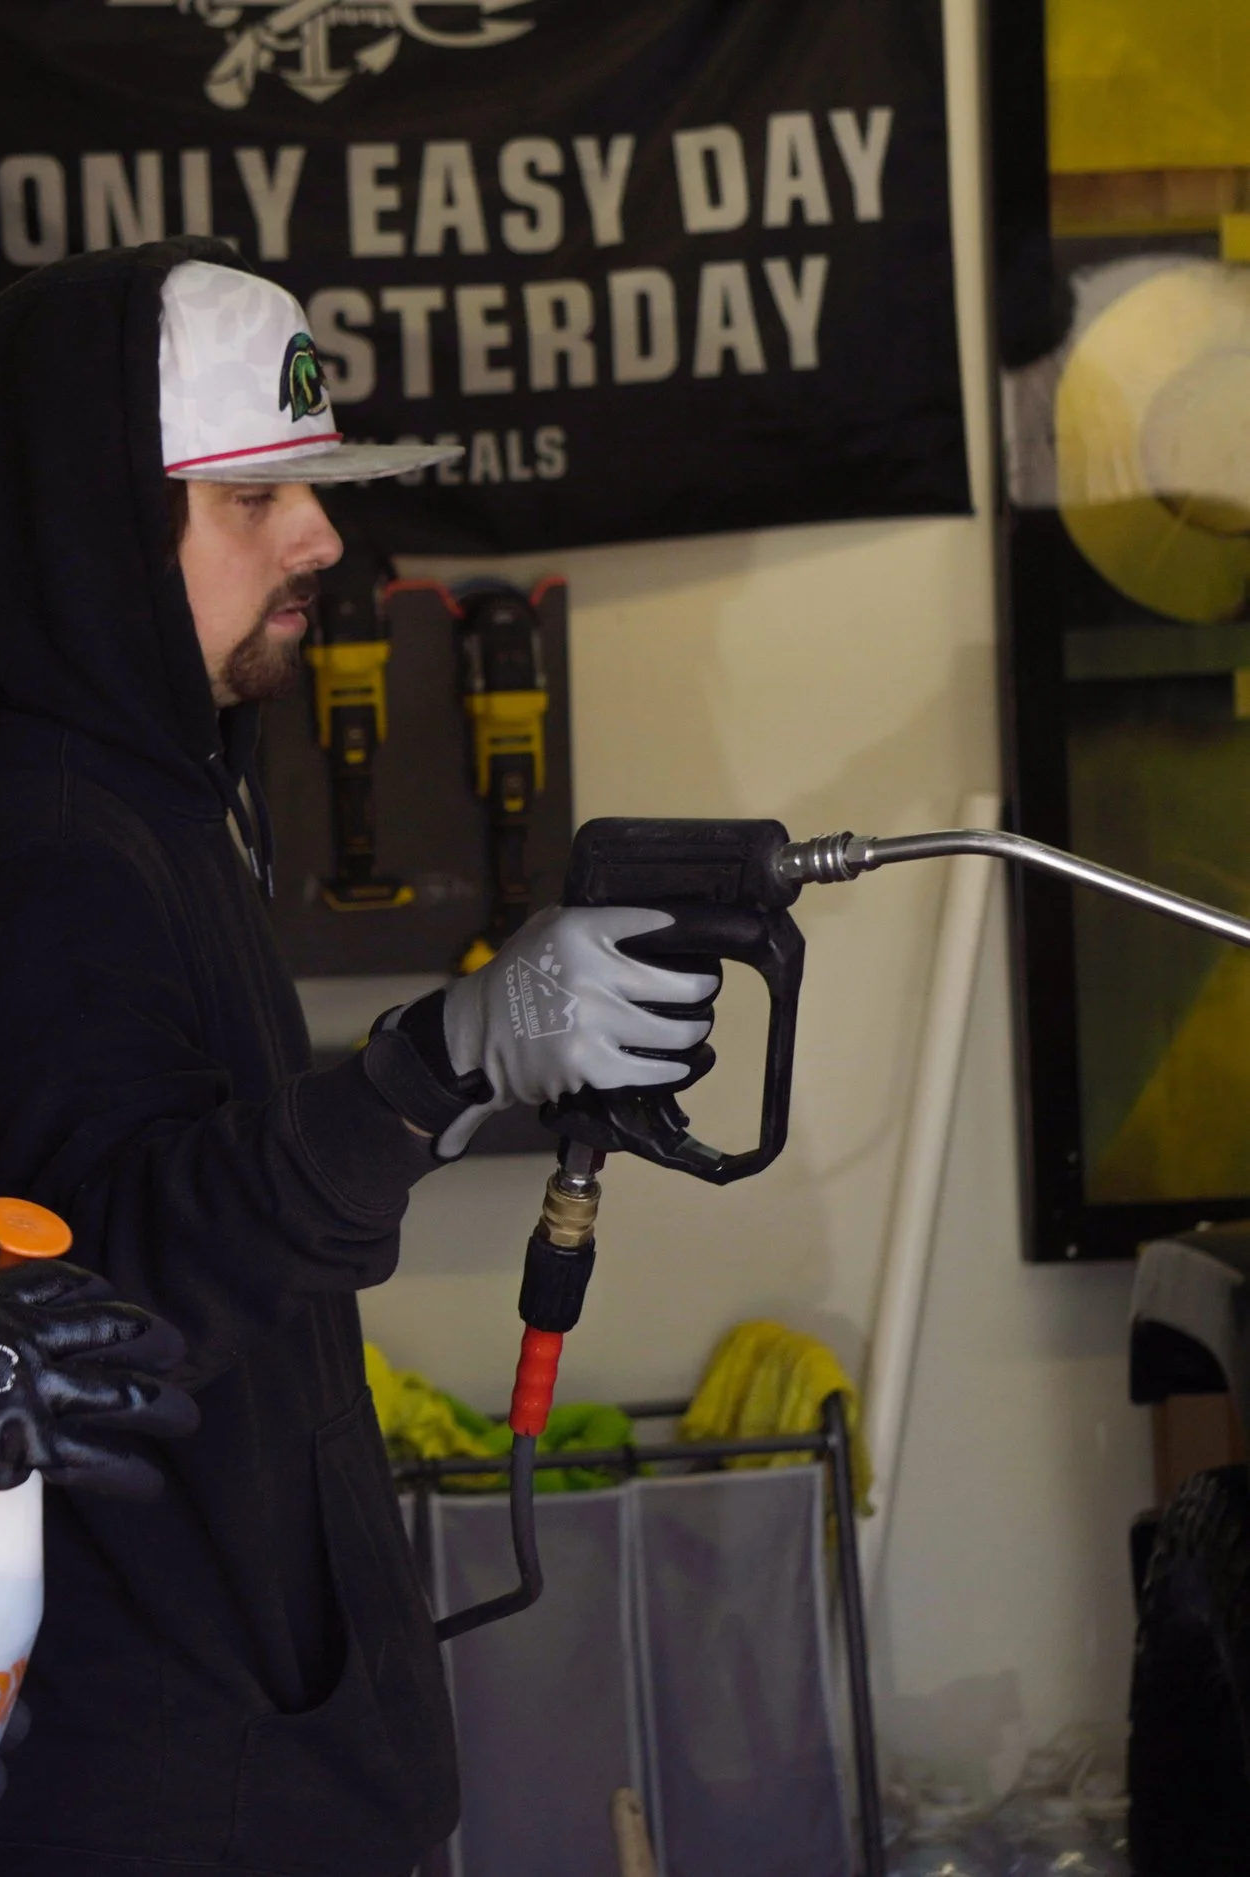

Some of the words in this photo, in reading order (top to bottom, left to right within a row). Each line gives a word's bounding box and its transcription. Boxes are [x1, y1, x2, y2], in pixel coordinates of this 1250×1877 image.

[347, 133, 636, 258] EASY
[672, 106, 894, 234] DAY
[307, 255, 830, 402] STERDAY
[505, 963, 525, 1039] toolant
[521, 969, 535, 1003] WATER
